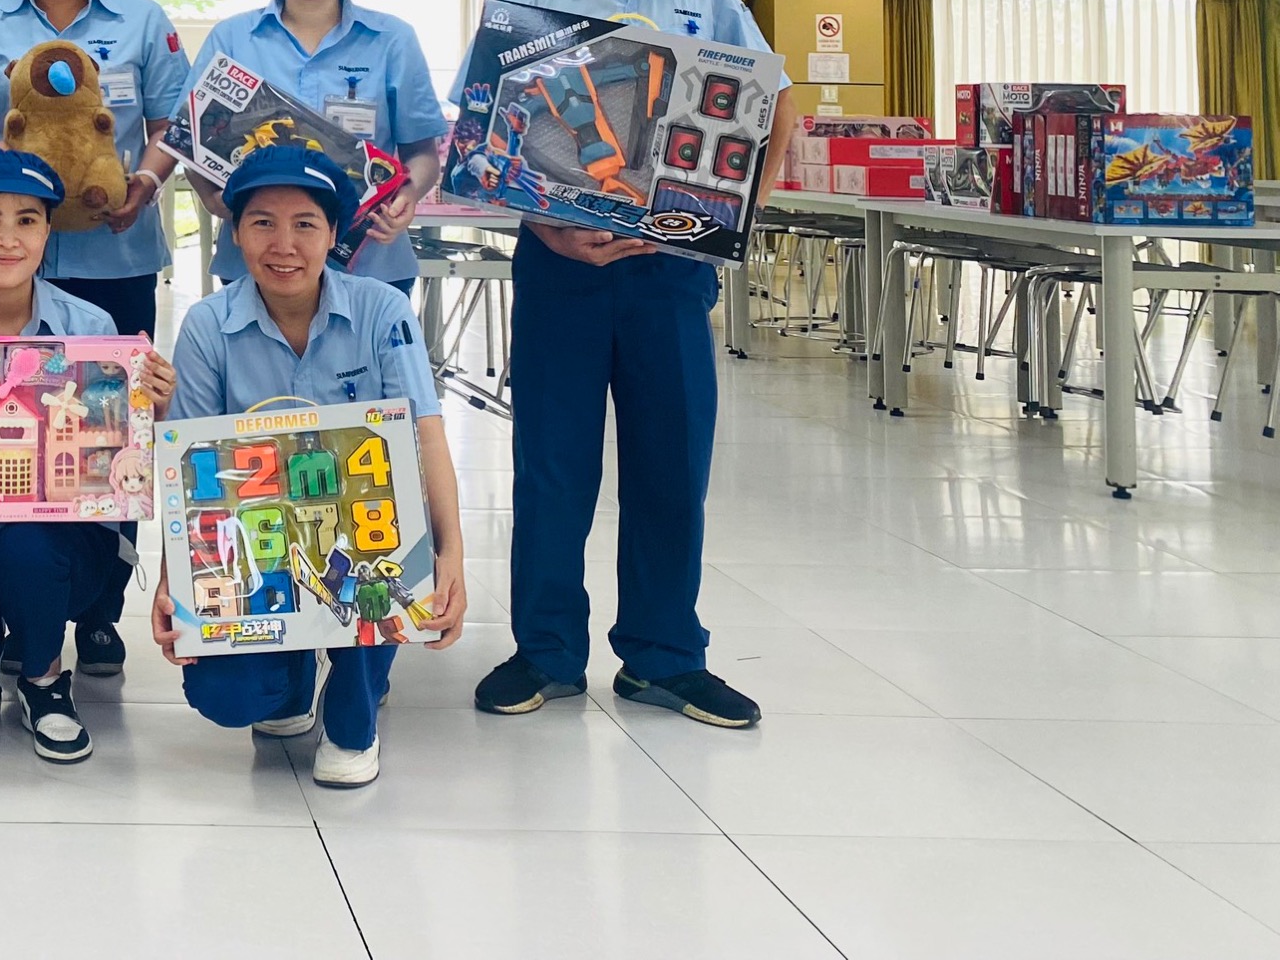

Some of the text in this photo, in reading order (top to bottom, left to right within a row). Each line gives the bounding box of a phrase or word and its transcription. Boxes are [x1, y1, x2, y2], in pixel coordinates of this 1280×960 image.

[497, 33, 557, 66] TRANSMIT
[697, 48, 756, 68] FIREPOWER
[206, 69, 249, 101] MOTO
[229, 67, 256, 87] RACE
[1003, 91, 1030, 101] MOTO
[757, 107, 767, 129] AGES
[1079, 164, 1087, 200] NINJA
[662, 217, 683, 228] 25
[235, 412, 319, 434] DEFORMED
